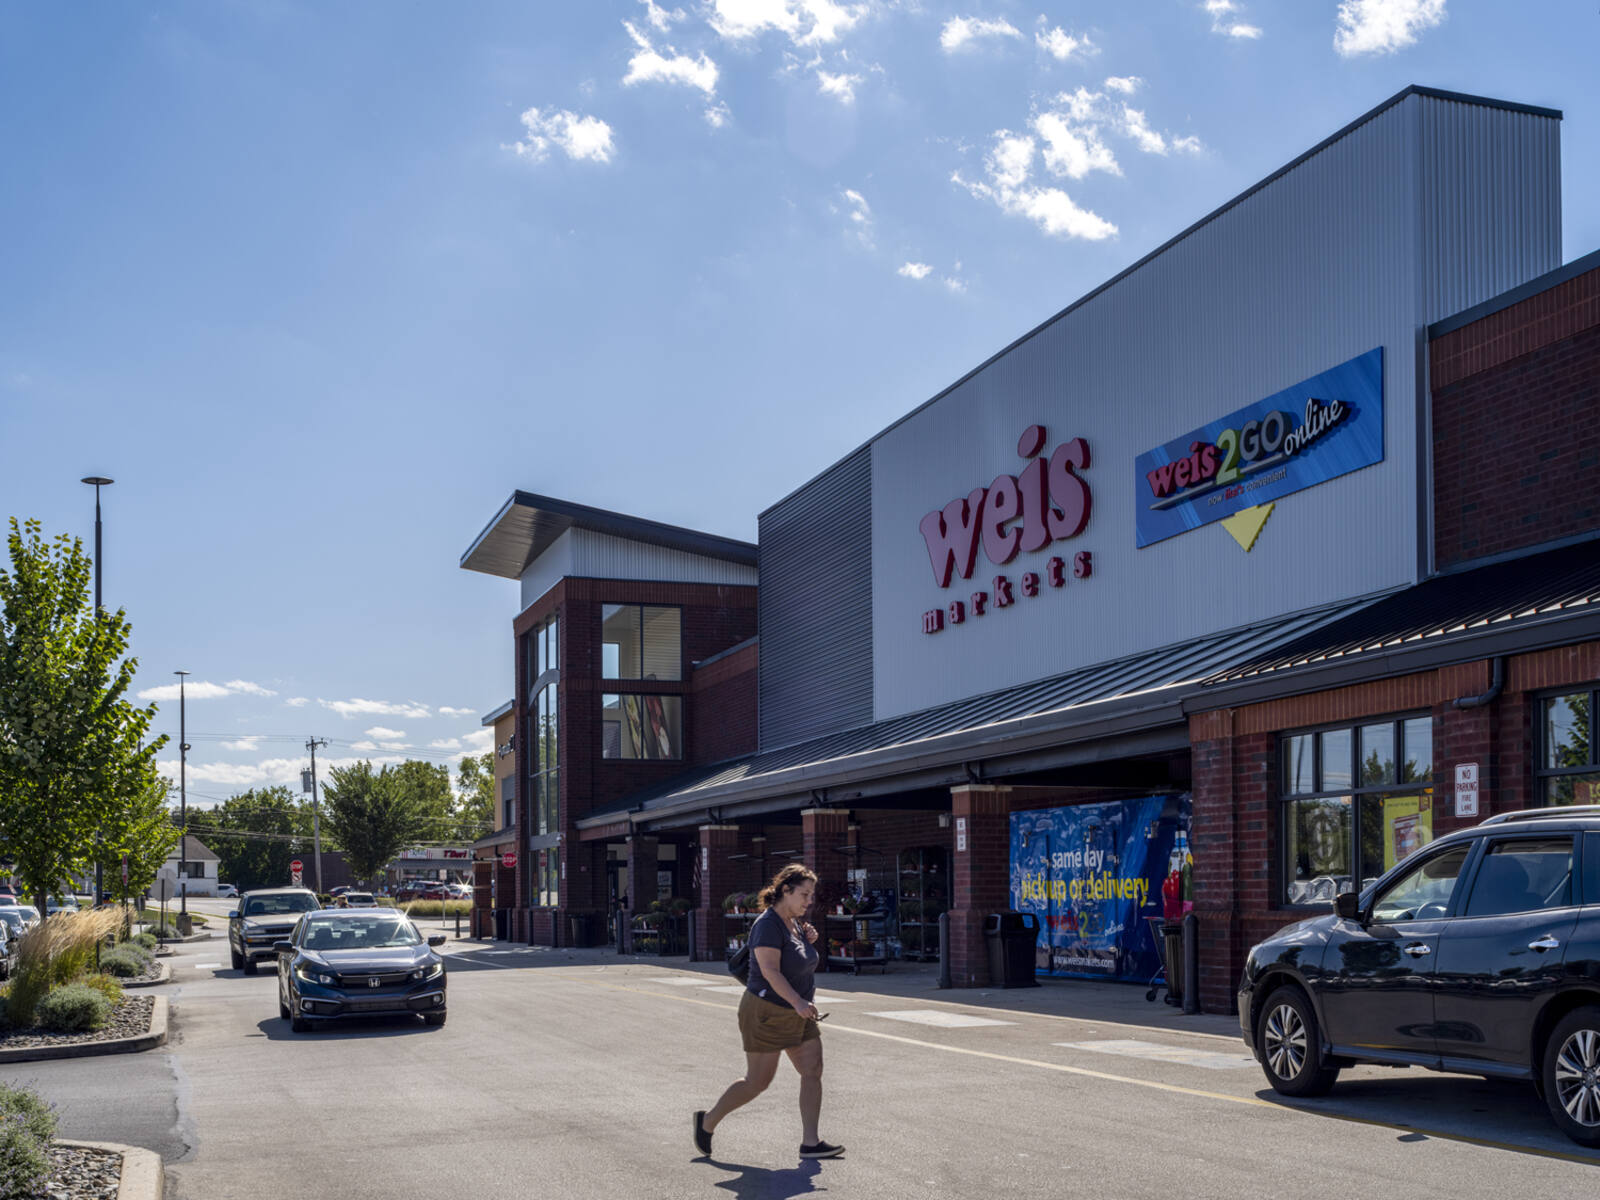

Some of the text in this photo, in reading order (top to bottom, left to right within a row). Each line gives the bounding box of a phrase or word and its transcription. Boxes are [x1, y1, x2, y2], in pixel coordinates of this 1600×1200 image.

[1284, 397, 1350, 457] online
[1207, 494, 1223, 506] now
[1246, 466, 1288, 492] convenient
[919, 424, 1092, 588] weis
[921, 551, 1093, 634] markets
[1456, 782, 1477, 792] PARKING
[1462, 769, 1472, 780] NO
[1461, 804, 1472, 812] LANE
[1052, 844, 1104, 873] same day
[1069, 878, 1085, 900] or
[1086, 871, 1149, 908] delivery
